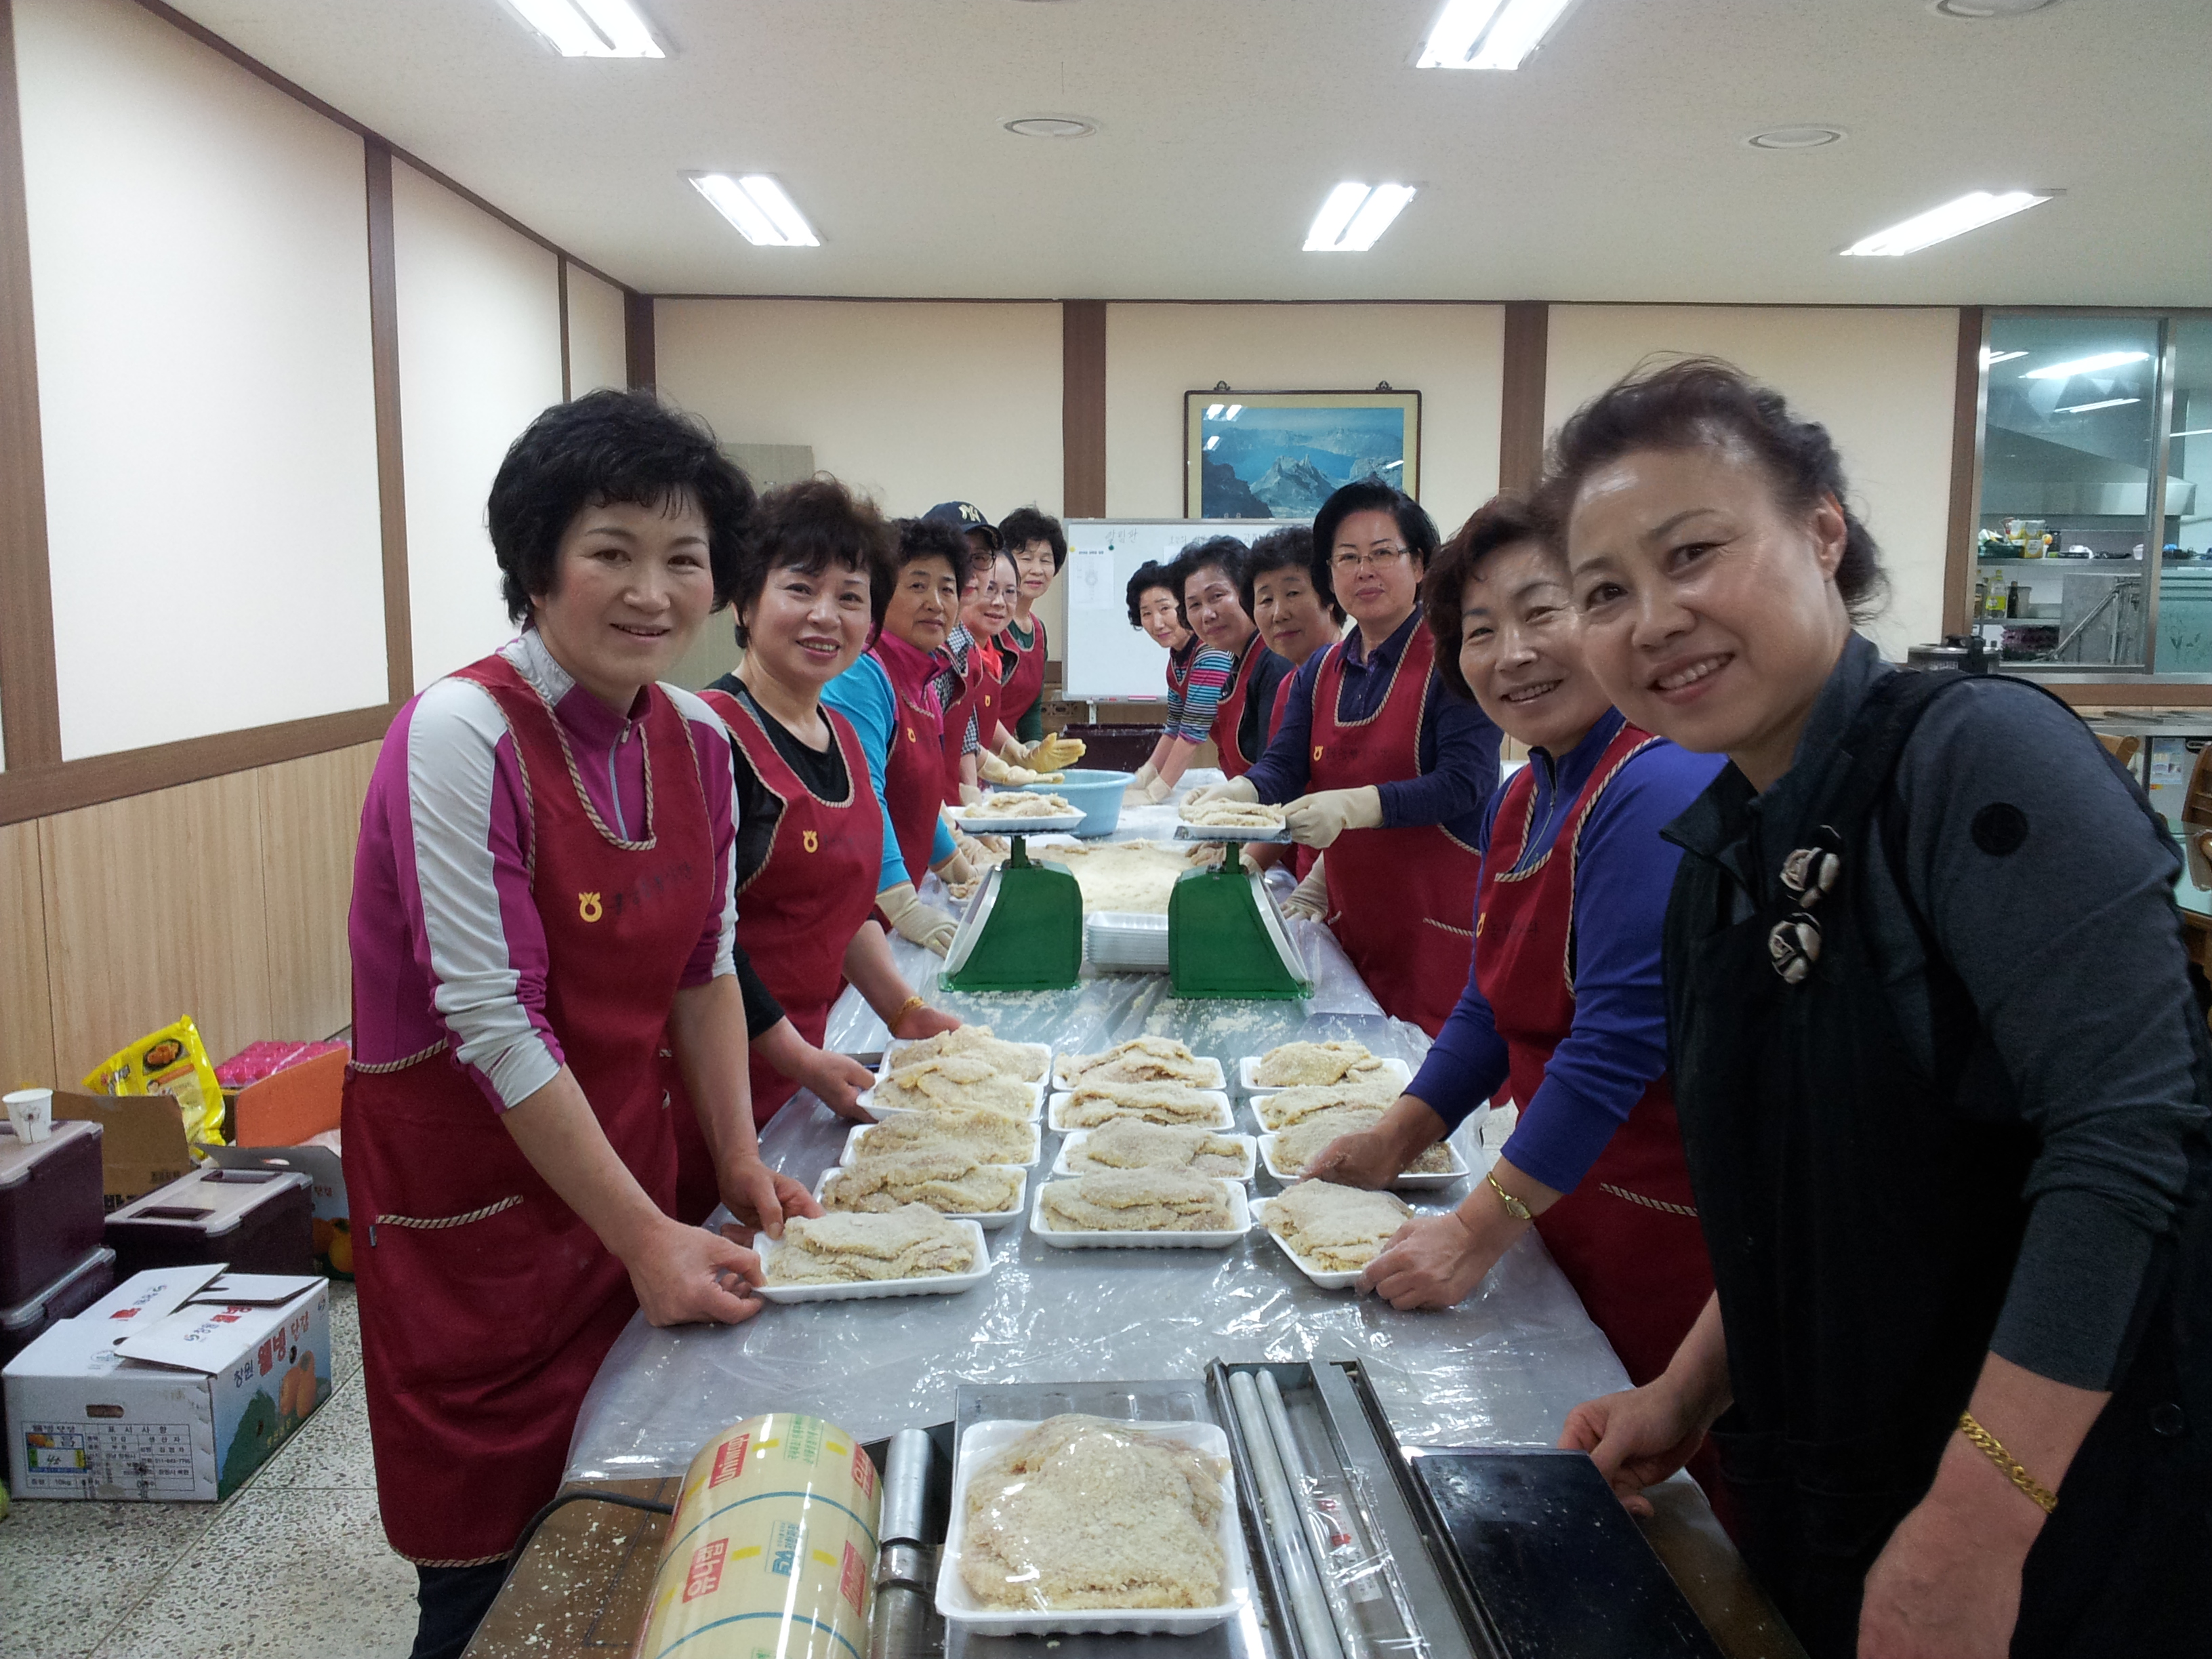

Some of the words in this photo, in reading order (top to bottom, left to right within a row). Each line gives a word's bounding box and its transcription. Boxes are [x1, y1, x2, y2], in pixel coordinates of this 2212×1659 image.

[1105, 527, 1139, 545] 알림판
[234, 1359, 254, 1388] 창원
[257, 1326, 287, 1377] 웰빙
[291, 1310, 310, 1342] 단감
[687, 1541, 724, 1597] 유니랩
